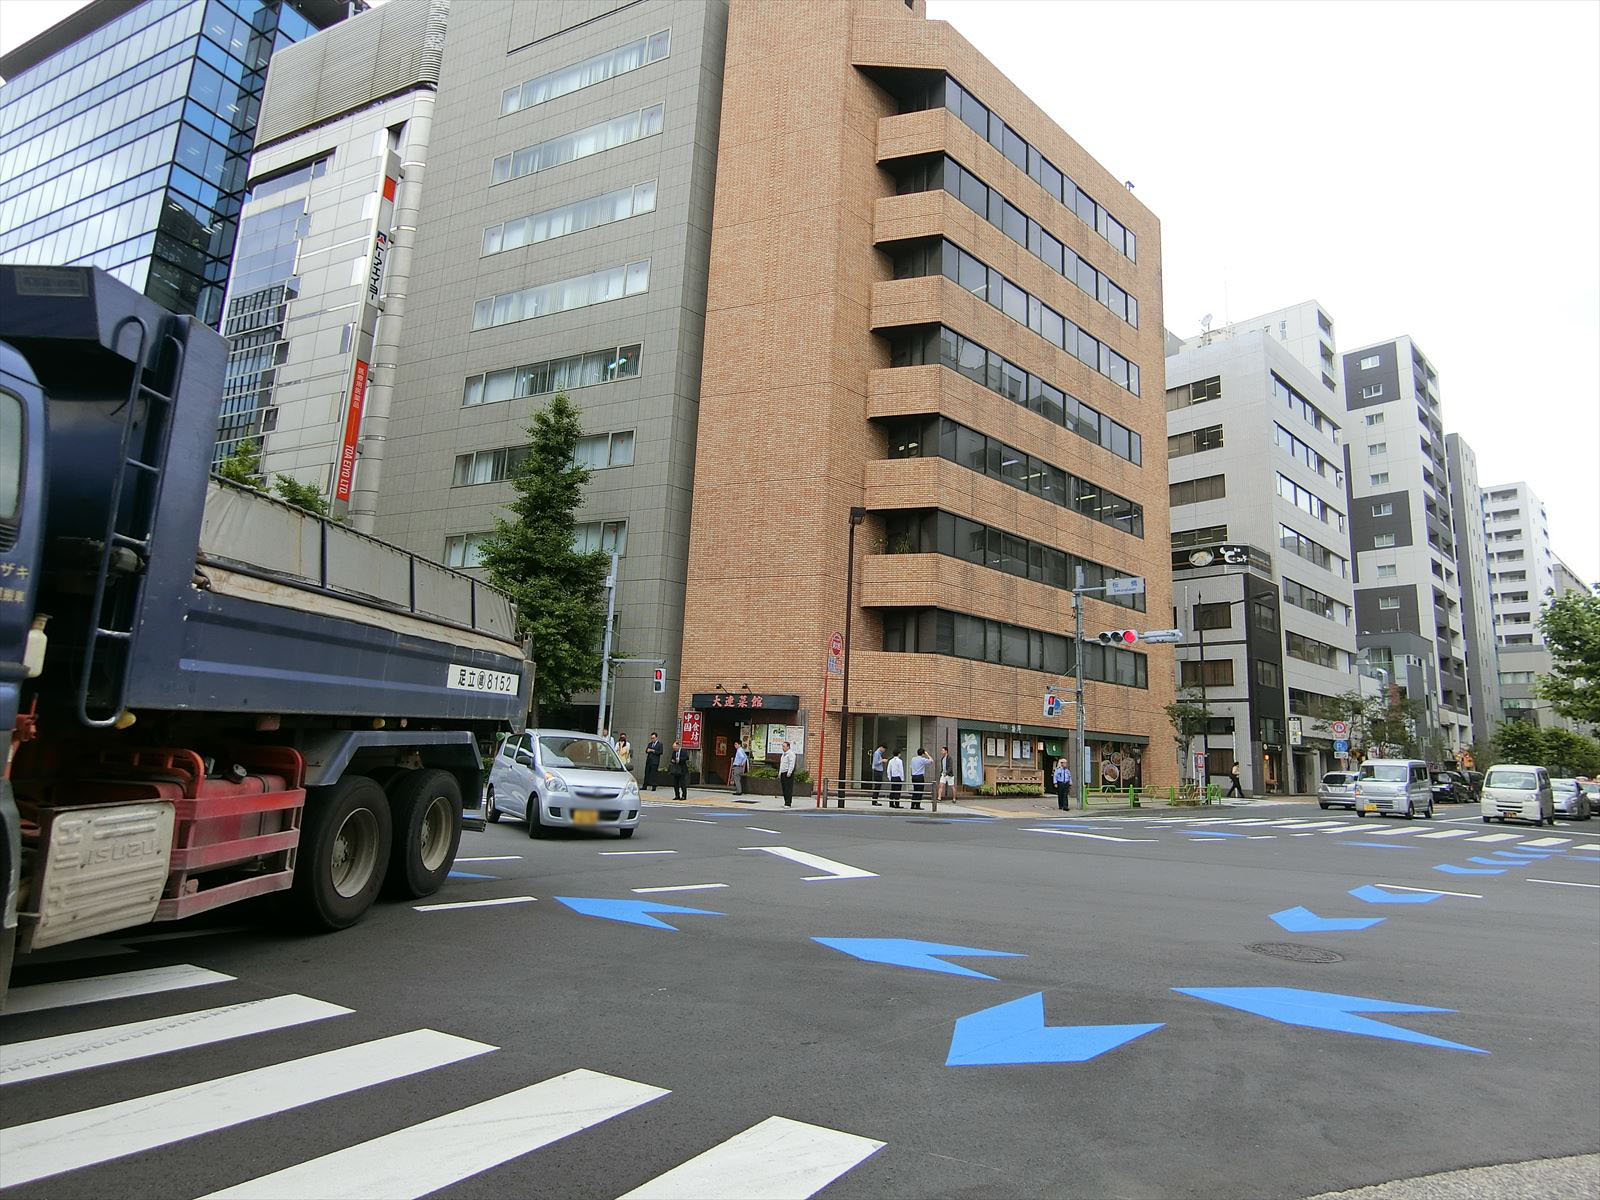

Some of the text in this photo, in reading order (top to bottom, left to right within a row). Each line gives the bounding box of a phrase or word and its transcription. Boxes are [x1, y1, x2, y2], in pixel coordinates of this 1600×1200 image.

[338, 444, 355, 495] TOA EIYO LTD.
[86, 839, 156, 866] ISUZU
